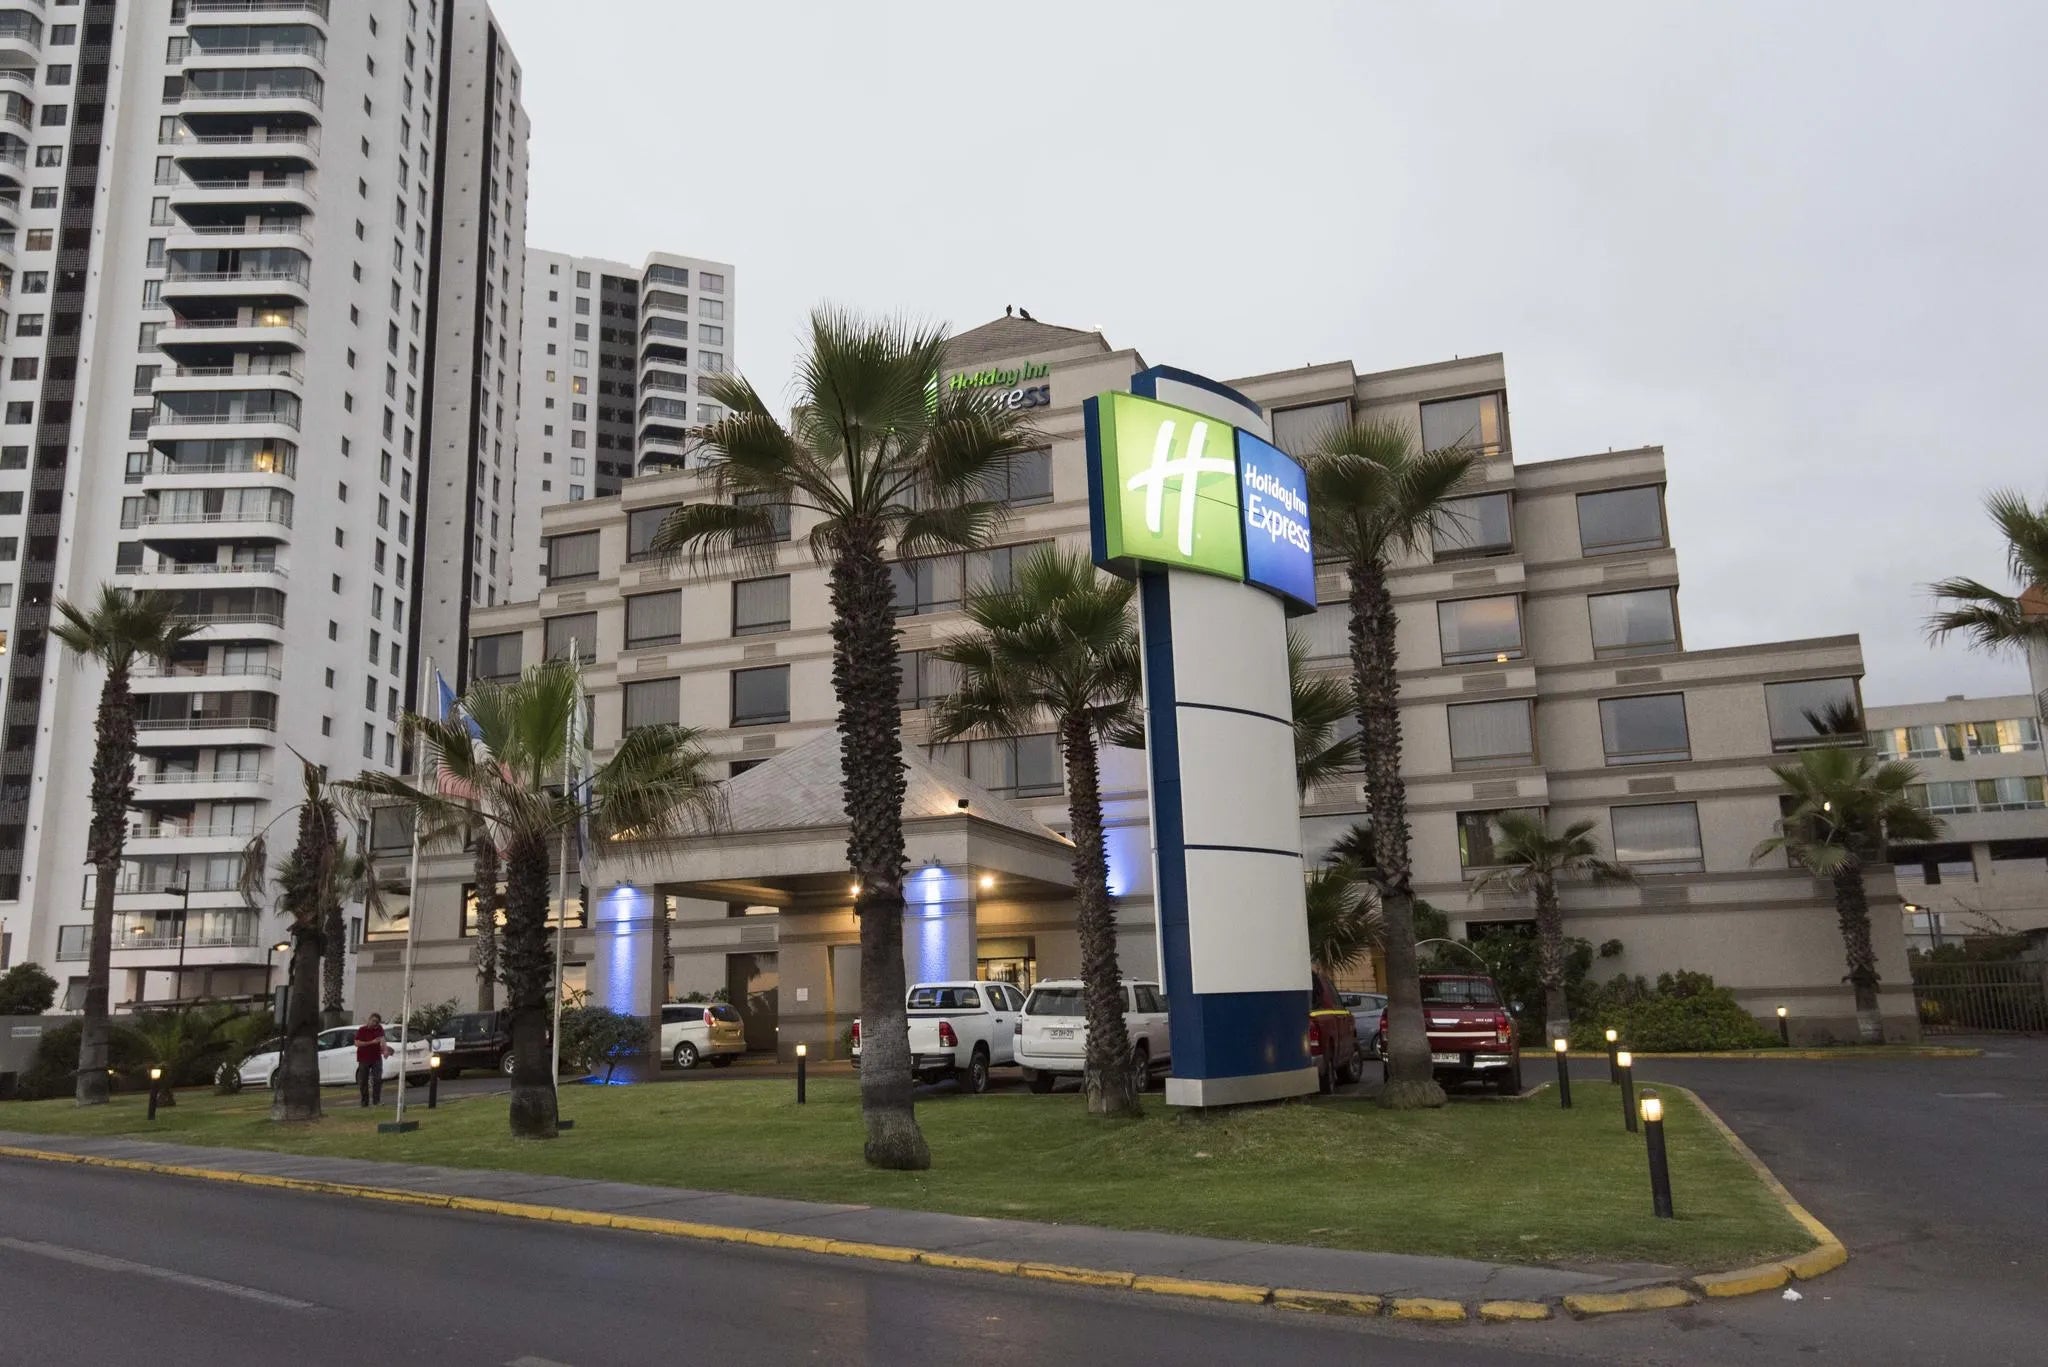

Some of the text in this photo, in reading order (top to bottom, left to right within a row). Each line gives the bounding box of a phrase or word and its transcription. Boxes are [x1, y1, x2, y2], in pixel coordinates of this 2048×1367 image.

[949, 360, 1051, 391] Holiday Inn
[1244, 463, 1307, 517] Holiday Inn
[1248, 495, 1310, 553] Express
